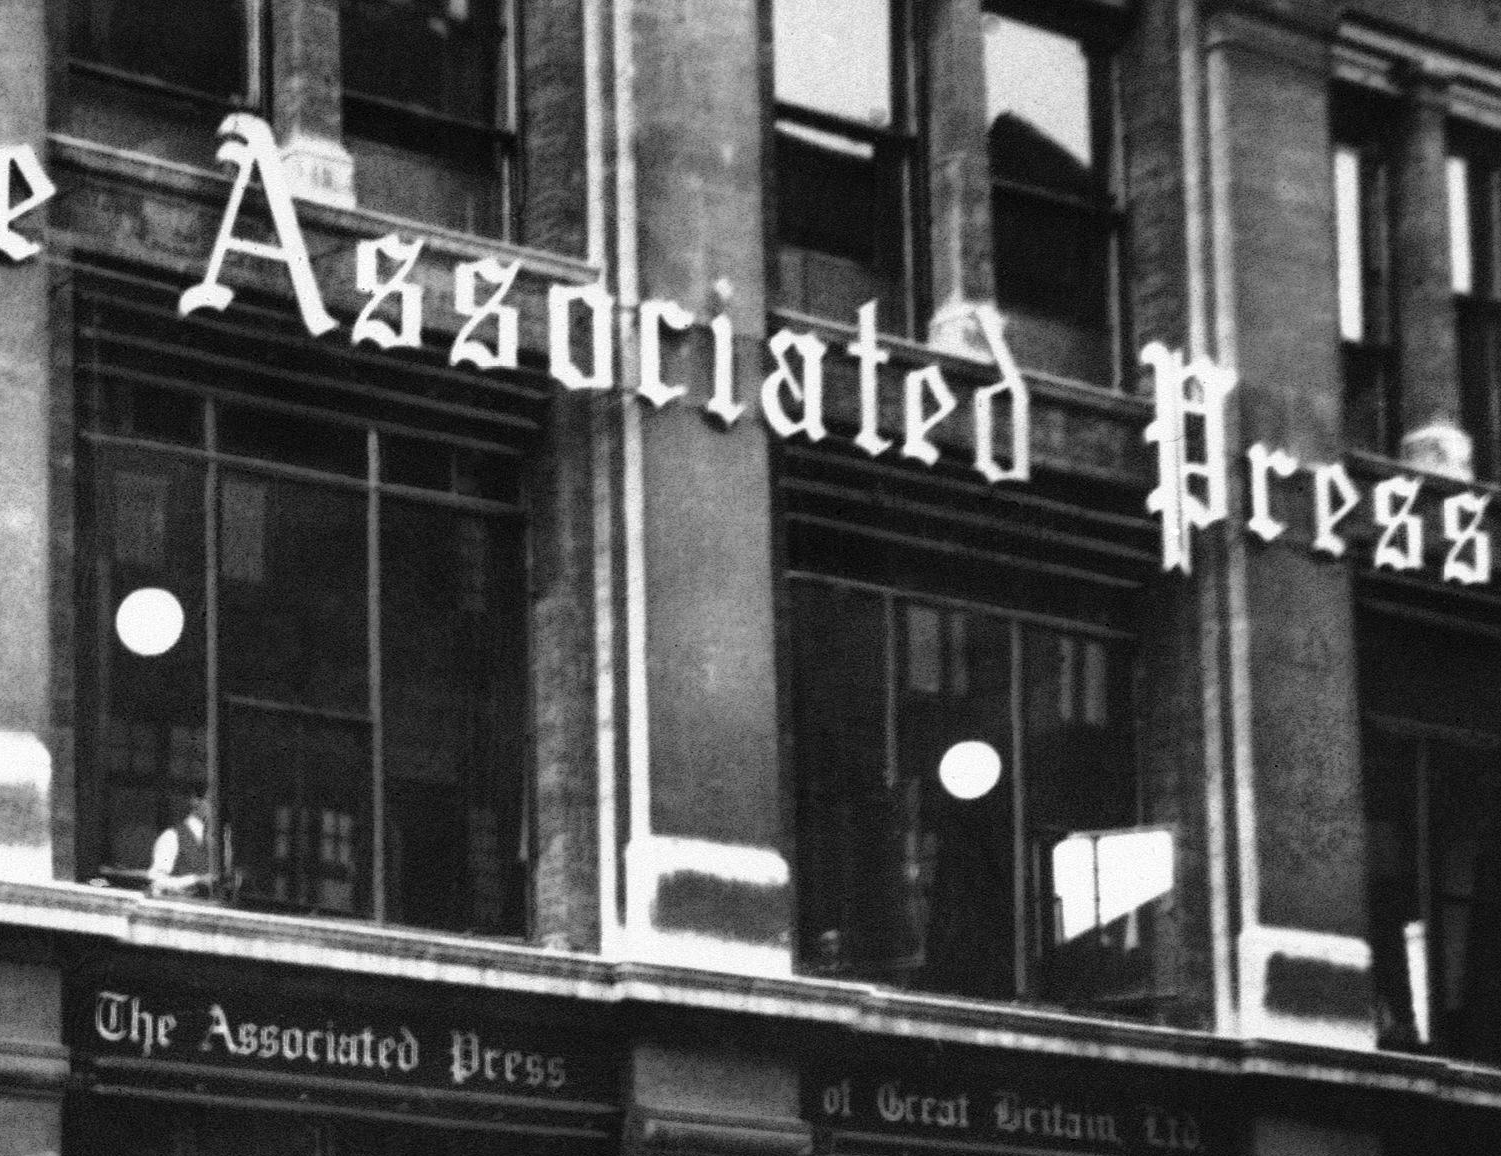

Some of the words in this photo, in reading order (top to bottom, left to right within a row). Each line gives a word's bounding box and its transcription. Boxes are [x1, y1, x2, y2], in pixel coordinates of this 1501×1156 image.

[177, 112, 1033, 482] Associated
[1140, 340, 1492, 584] Press
[95, 991, 177, 1056] The
[201, 1003, 419, 1072] Associated
[451, 1028, 566, 1088] Press
[822, 1076, 852, 1117] of
[876, 1080, 969, 1128] Great
